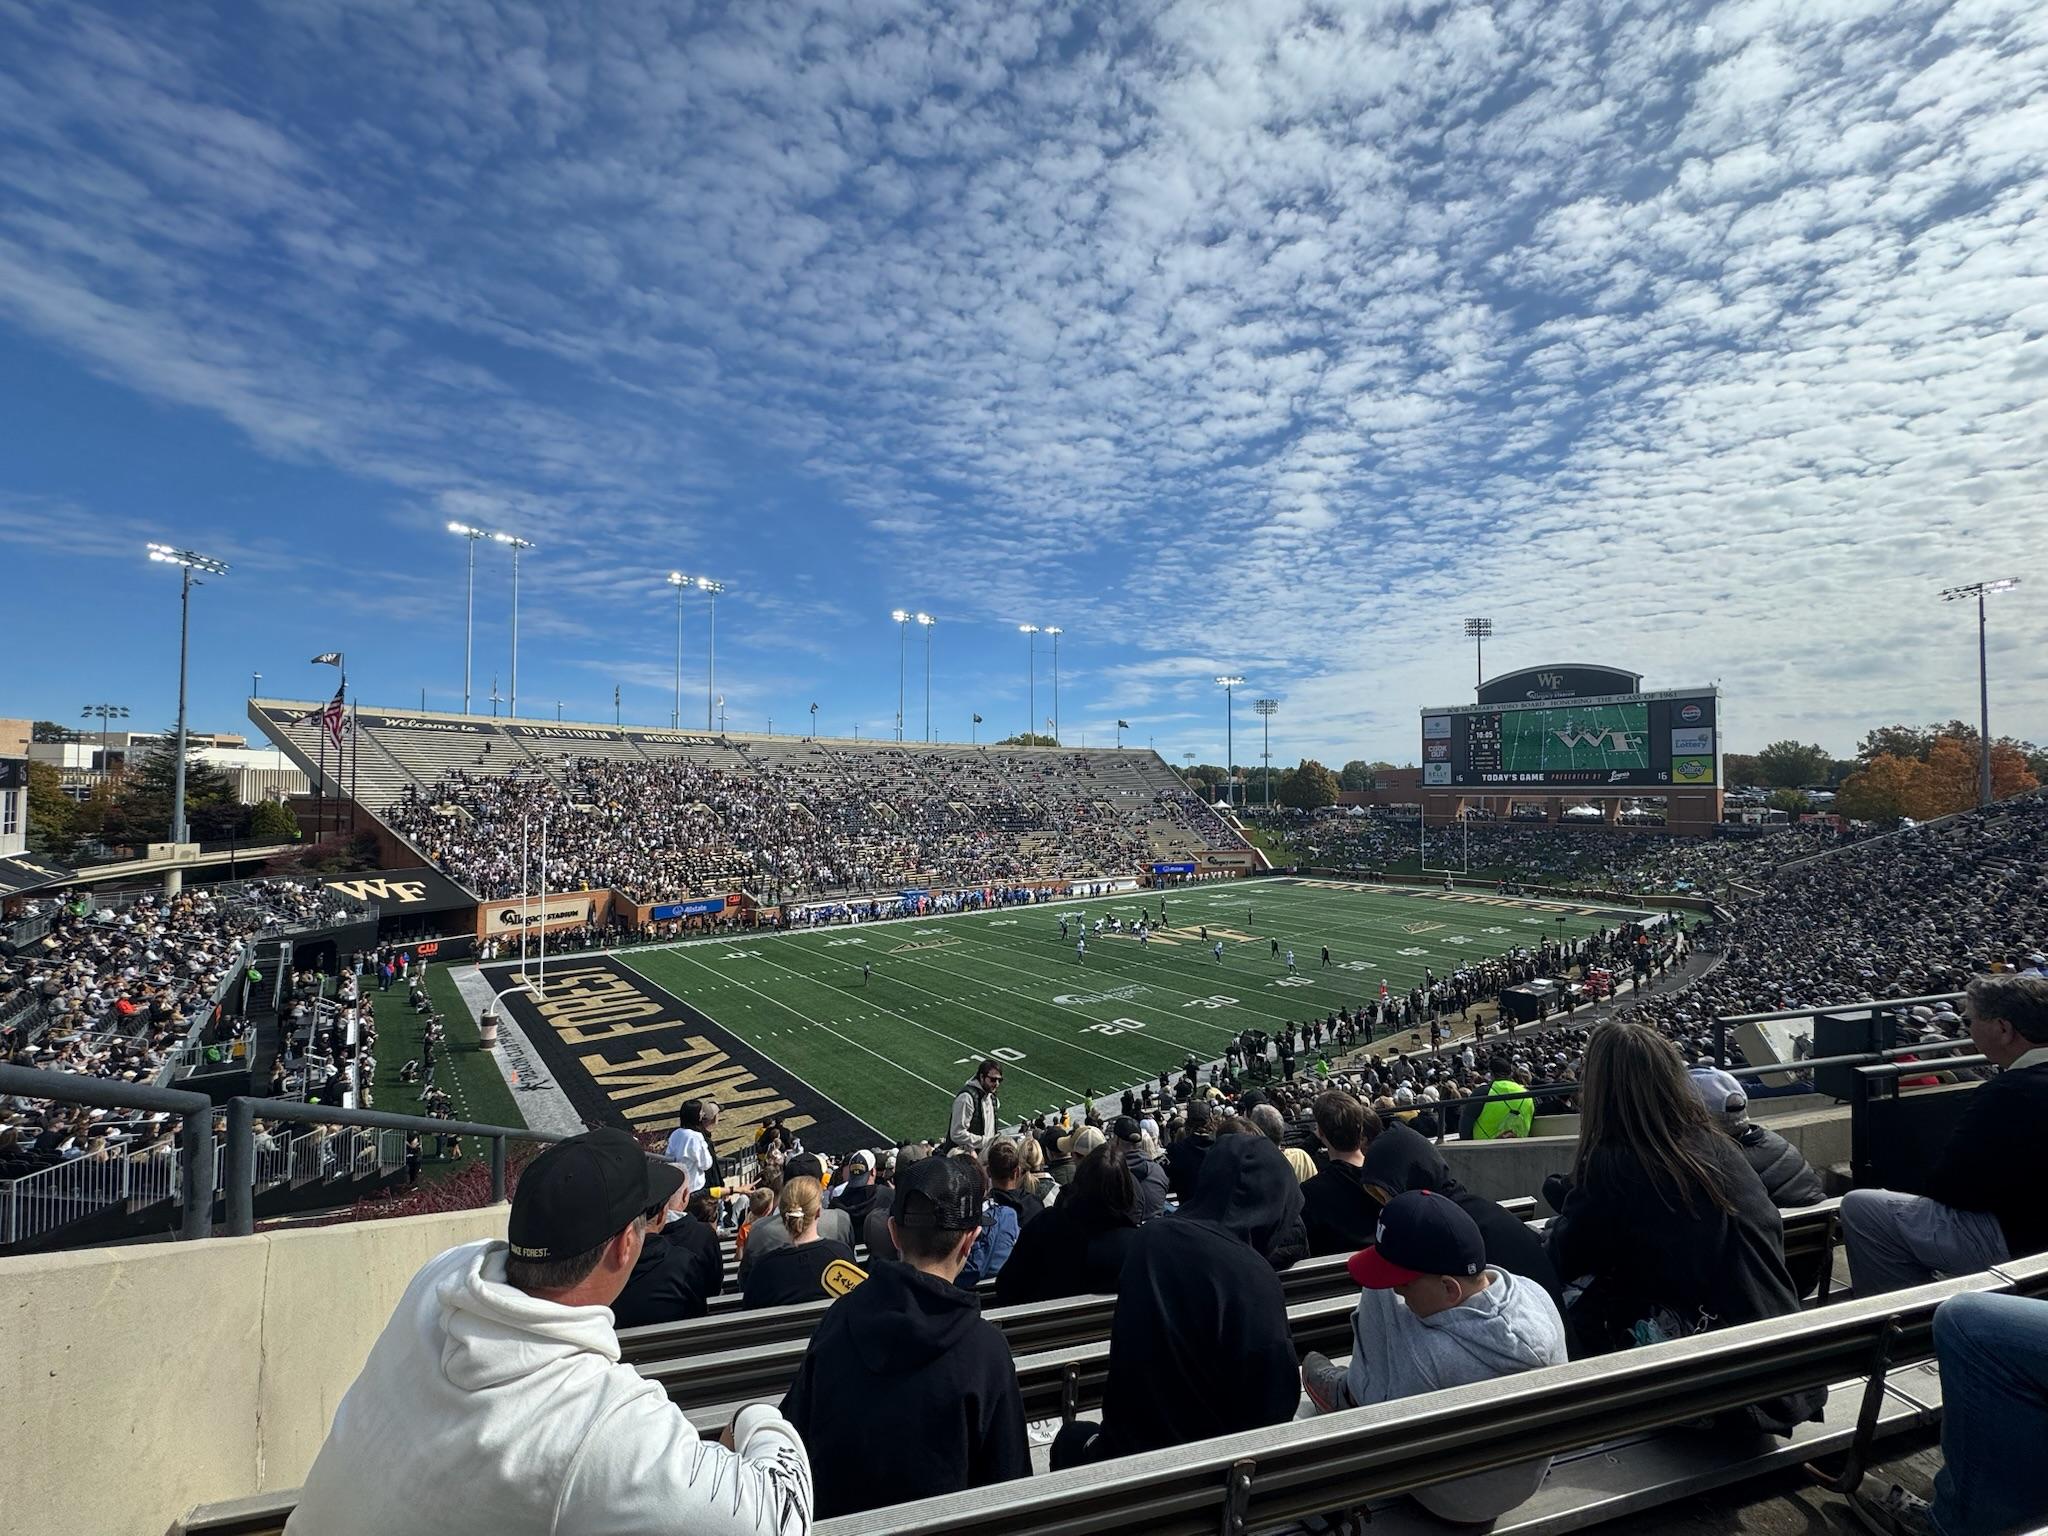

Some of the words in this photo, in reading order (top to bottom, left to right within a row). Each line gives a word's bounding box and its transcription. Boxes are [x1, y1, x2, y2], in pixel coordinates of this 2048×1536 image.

[1537, 672, 1563, 689] WF
[1550, 698, 1592, 706] HONORING
[1616, 693, 1641, 701] CLASS
[381, 717, 458, 732] Welcome
[461, 724, 480, 732] to
[520, 727, 611, 739] DEACTOWN
[643, 734, 715, 745] #GODEACS
[1675, 741, 1707, 749] Lottery
[1481, 774, 1518, 782] TODAY'S
[1519, 773, 1545, 781] GAME
[1657, 772, 1668, 780] 16
[324, 879, 427, 903] WF
[684, 905, 708, 914] Allstate
[1408, 892, 1613, 916] FOREST
[546, 910, 578, 921] STADIUM
[417, 942, 439, 954] CW
[1190, 995, 1241, 1009] 30
[1089, 1017, 1146, 1035] 20
[970, 1047, 1027, 1062] 10
[522, 1247, 549, 1258] FOREST
